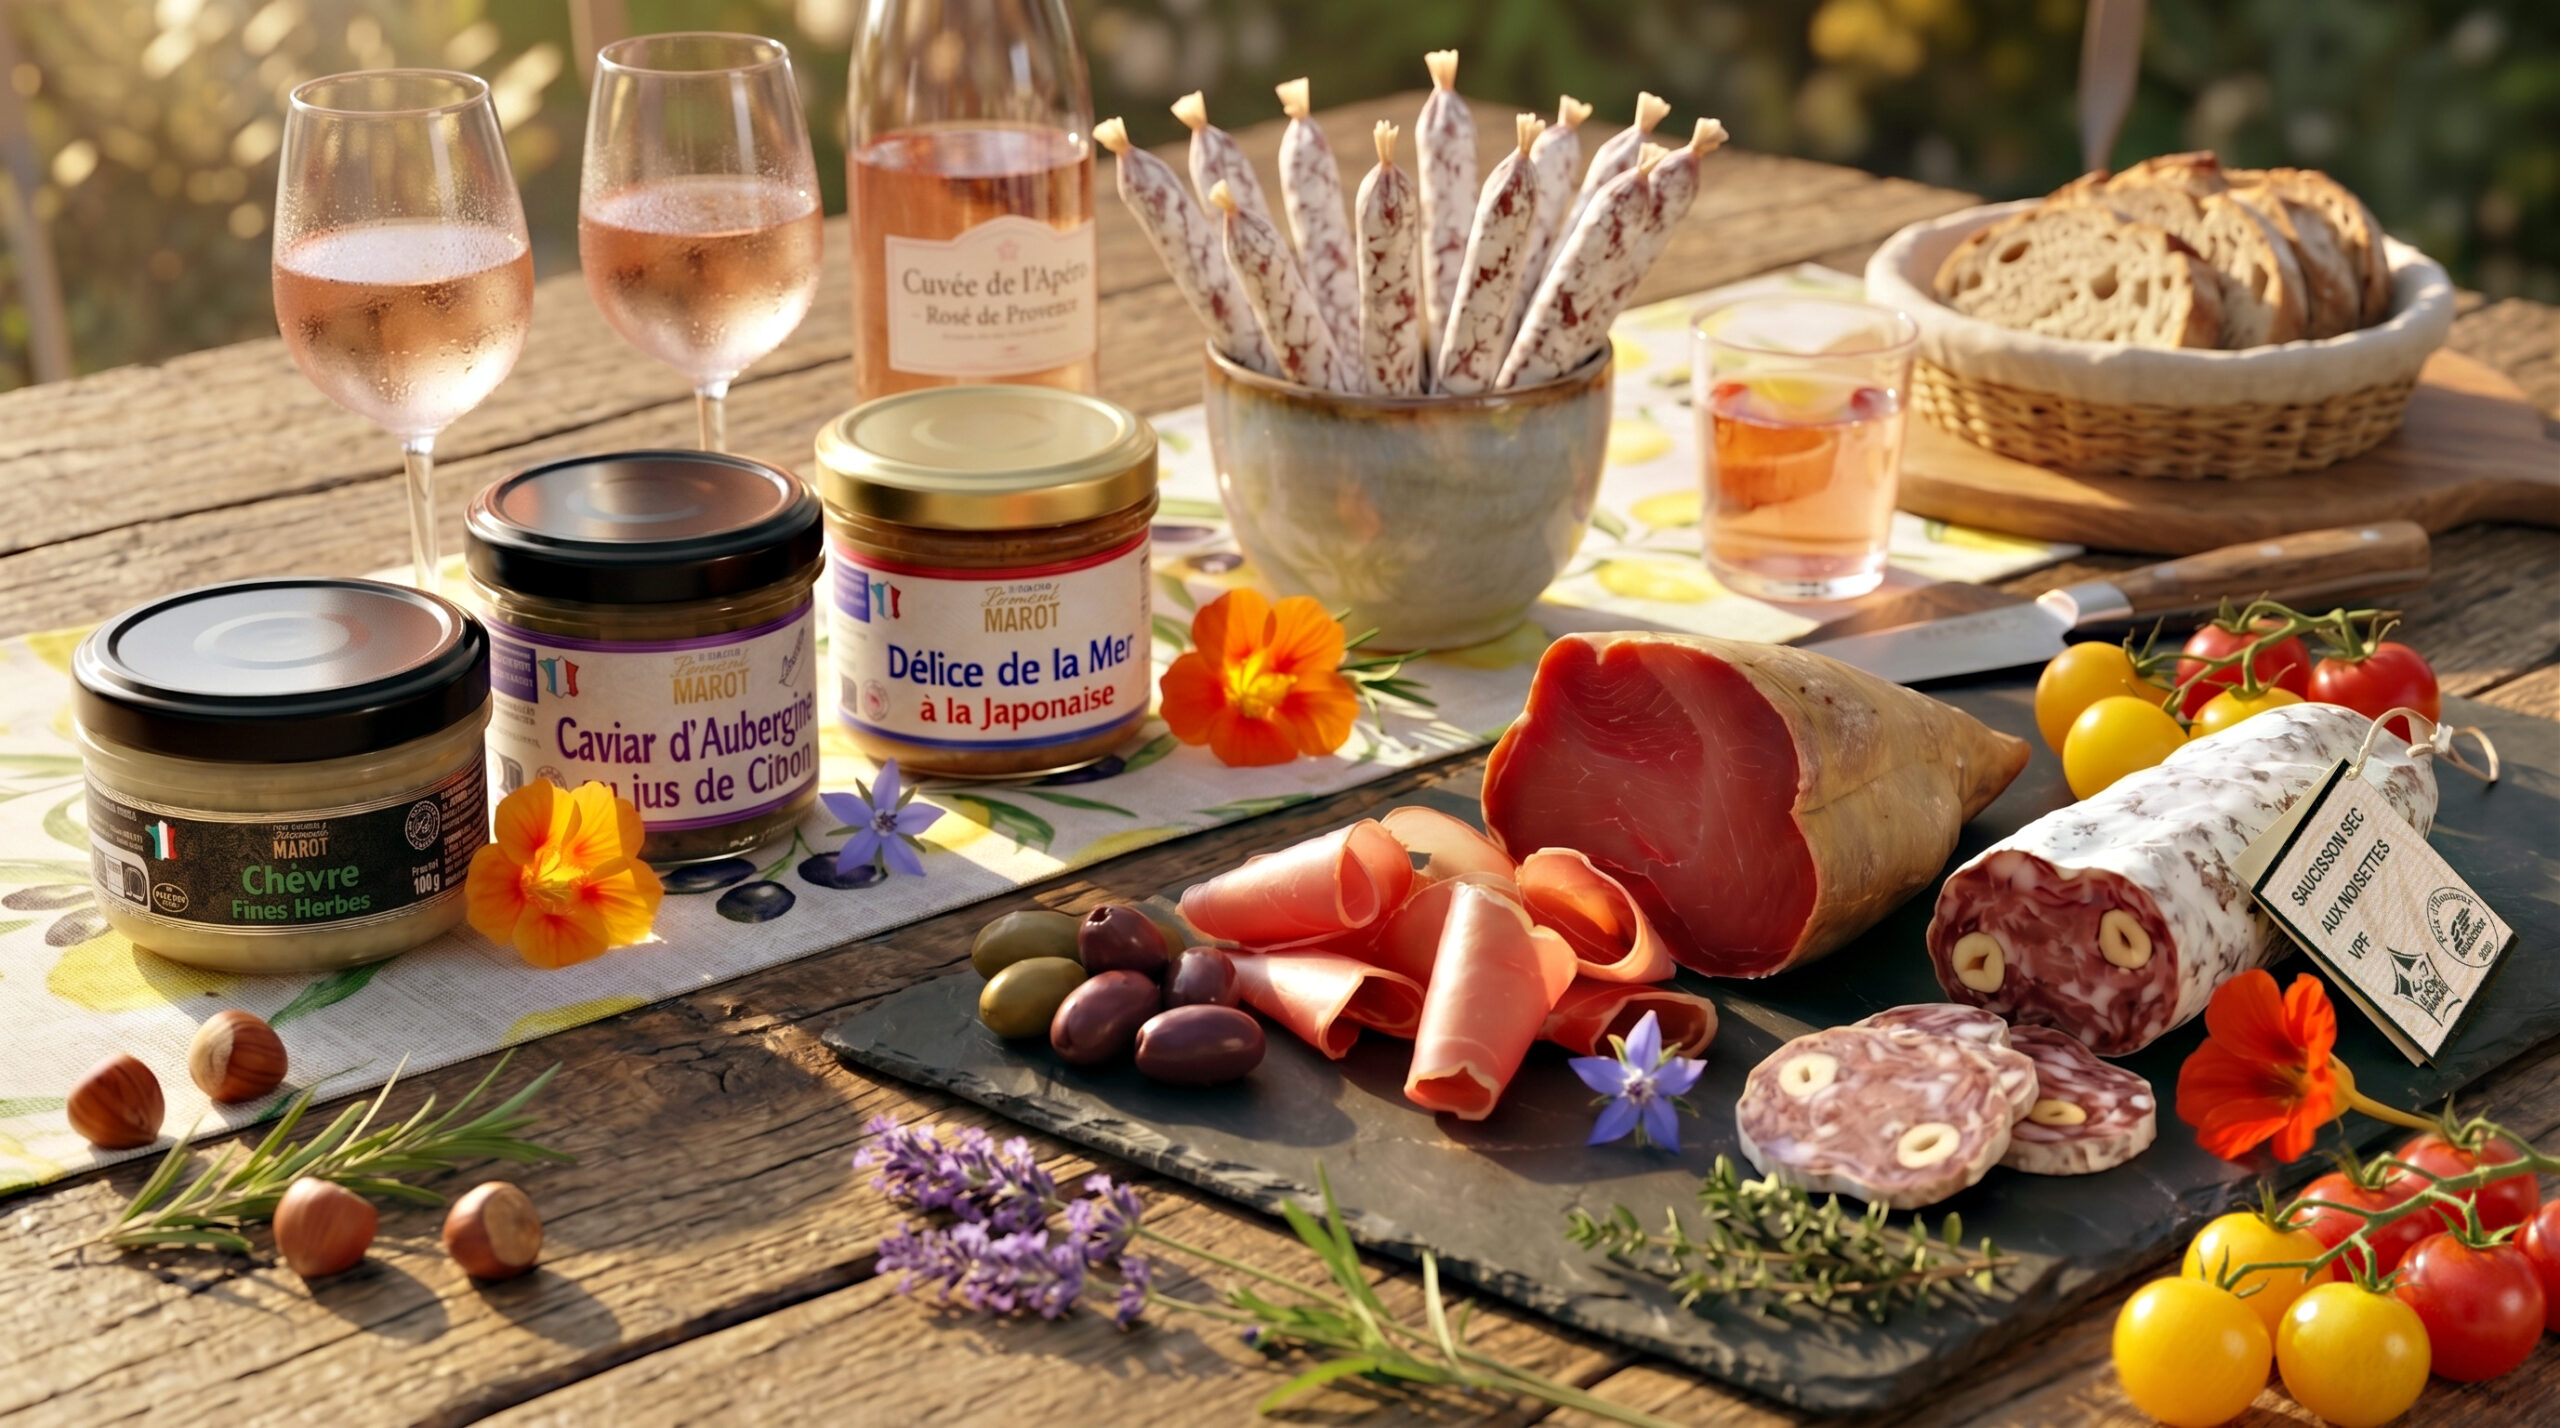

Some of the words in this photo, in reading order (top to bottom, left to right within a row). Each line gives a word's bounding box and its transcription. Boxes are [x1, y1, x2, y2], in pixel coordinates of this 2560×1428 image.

[902, 266, 980, 298] Cuvée
[986, 271, 1017, 295] de
[925, 304, 973, 327] Rosé
[976, 304, 1000, 327] de
[984, 601, 1061, 633] MAROT
[888, 644, 984, 688] Délice
[998, 651, 1041, 686] de
[1053, 648, 1079, 681] la
[1089, 633, 1134, 674] Mer
[672, 667, 751, 705] MAROT
[920, 694, 937, 723] à
[948, 697, 972, 725] la
[980, 685, 1115, 731] Japonaise
[557, 717, 657, 764] Caviar
[669, 690, 813, 763] d'Aubergine
[632, 773, 681, 813] jus
[694, 767, 735, 805] de
[273, 836, 329, 860] MAROT
[2291, 831, 2348, 907] SAUCISSON
[2340, 807, 2364, 837] SEC
[413, 872, 432, 896] 100
[2320, 902, 2347, 936] AUX
[2337, 839, 2390, 909] NOISETTES
[231, 899, 289, 920] Fines
[294, 893, 371, 918] Herbes
[2347, 930, 2371, 960] VPF
[2432, 918, 2448, 944] Prix
